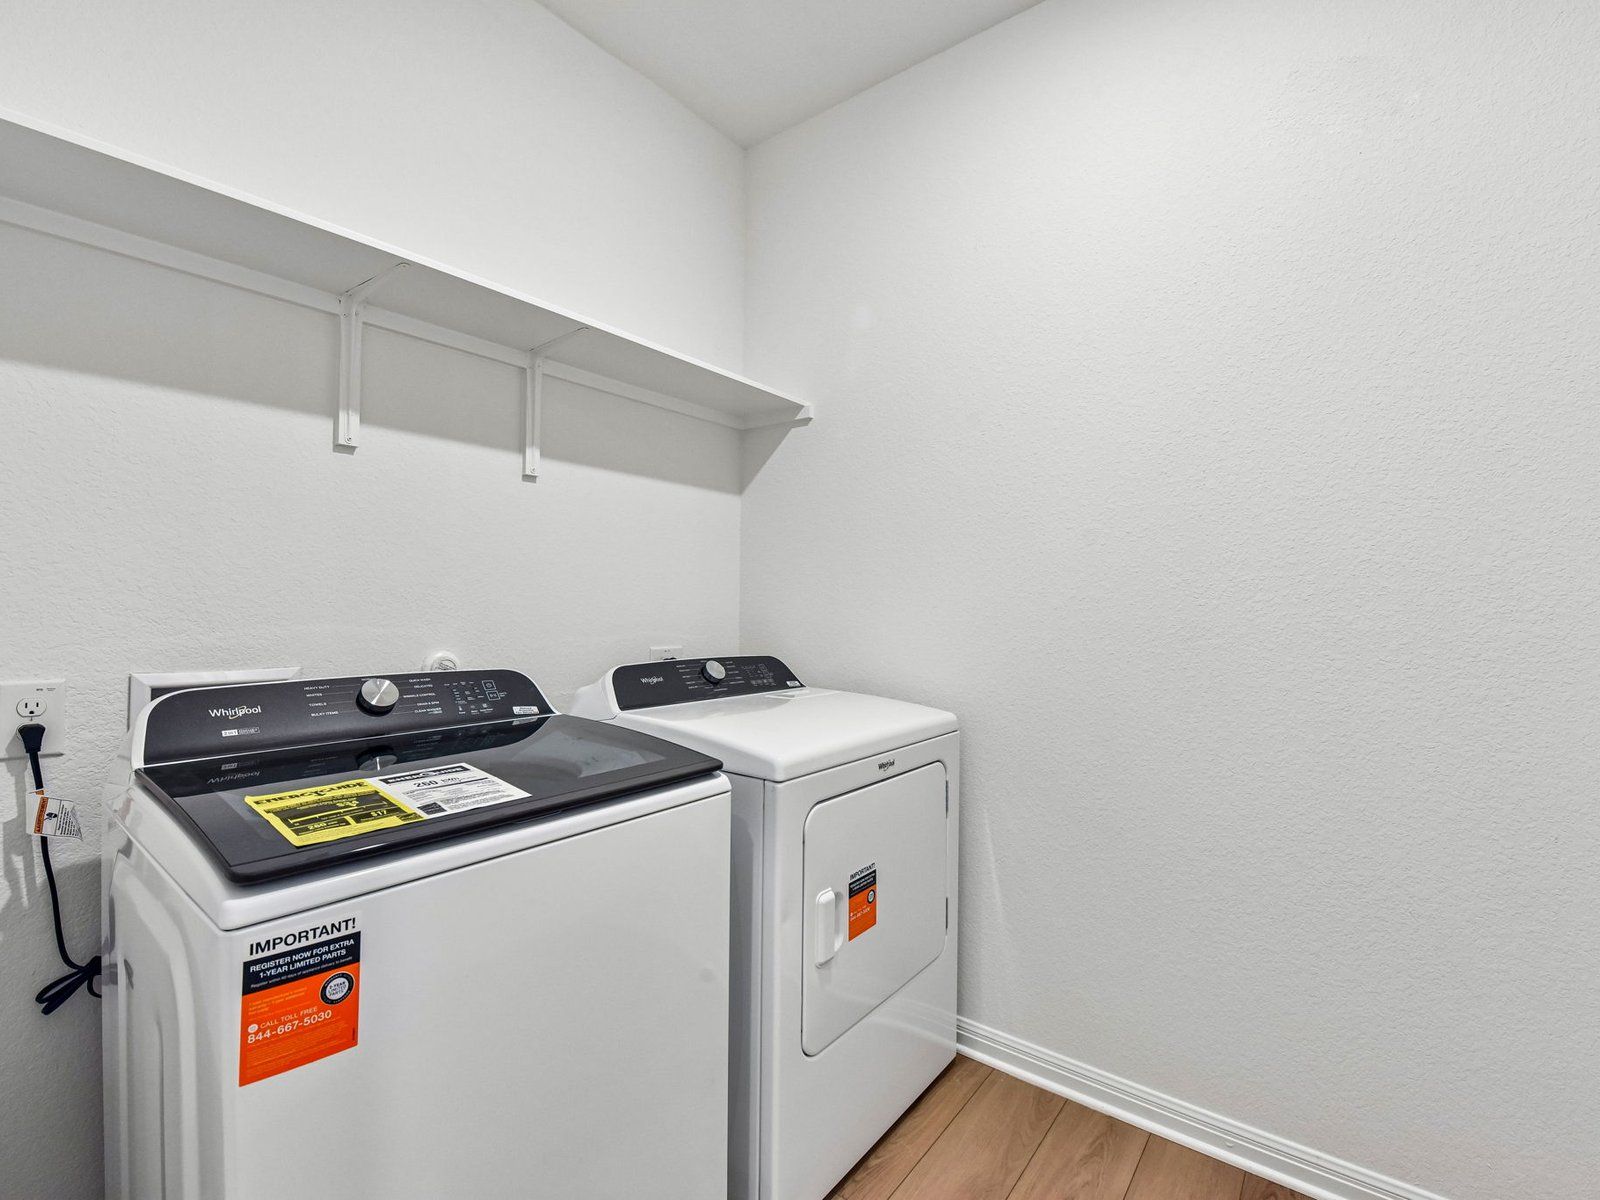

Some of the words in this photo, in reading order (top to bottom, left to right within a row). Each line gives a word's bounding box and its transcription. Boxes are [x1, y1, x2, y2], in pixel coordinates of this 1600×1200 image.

[640, 676, 664, 684] Whirlpool
[208, 705, 262, 719] Whirlpool
[249, 917, 356, 956] IMPORTANT!
[250, 956, 291, 973] REGISTER
[292, 950, 312, 963] NOW
[312, 945, 329, 956] FOR
[330, 938, 355, 951] EXTRA
[259, 965, 289, 979] 1-YEAR
[289, 956, 321, 970] LIMITED
[322, 949, 347, 961] PARTS
[247, 1009, 332, 1044] 844-667-5030
[260, 1019, 279, 1029] CALL
[281, 1013, 298, 1022] TOLL
[300, 1006, 318, 1016] FREE
